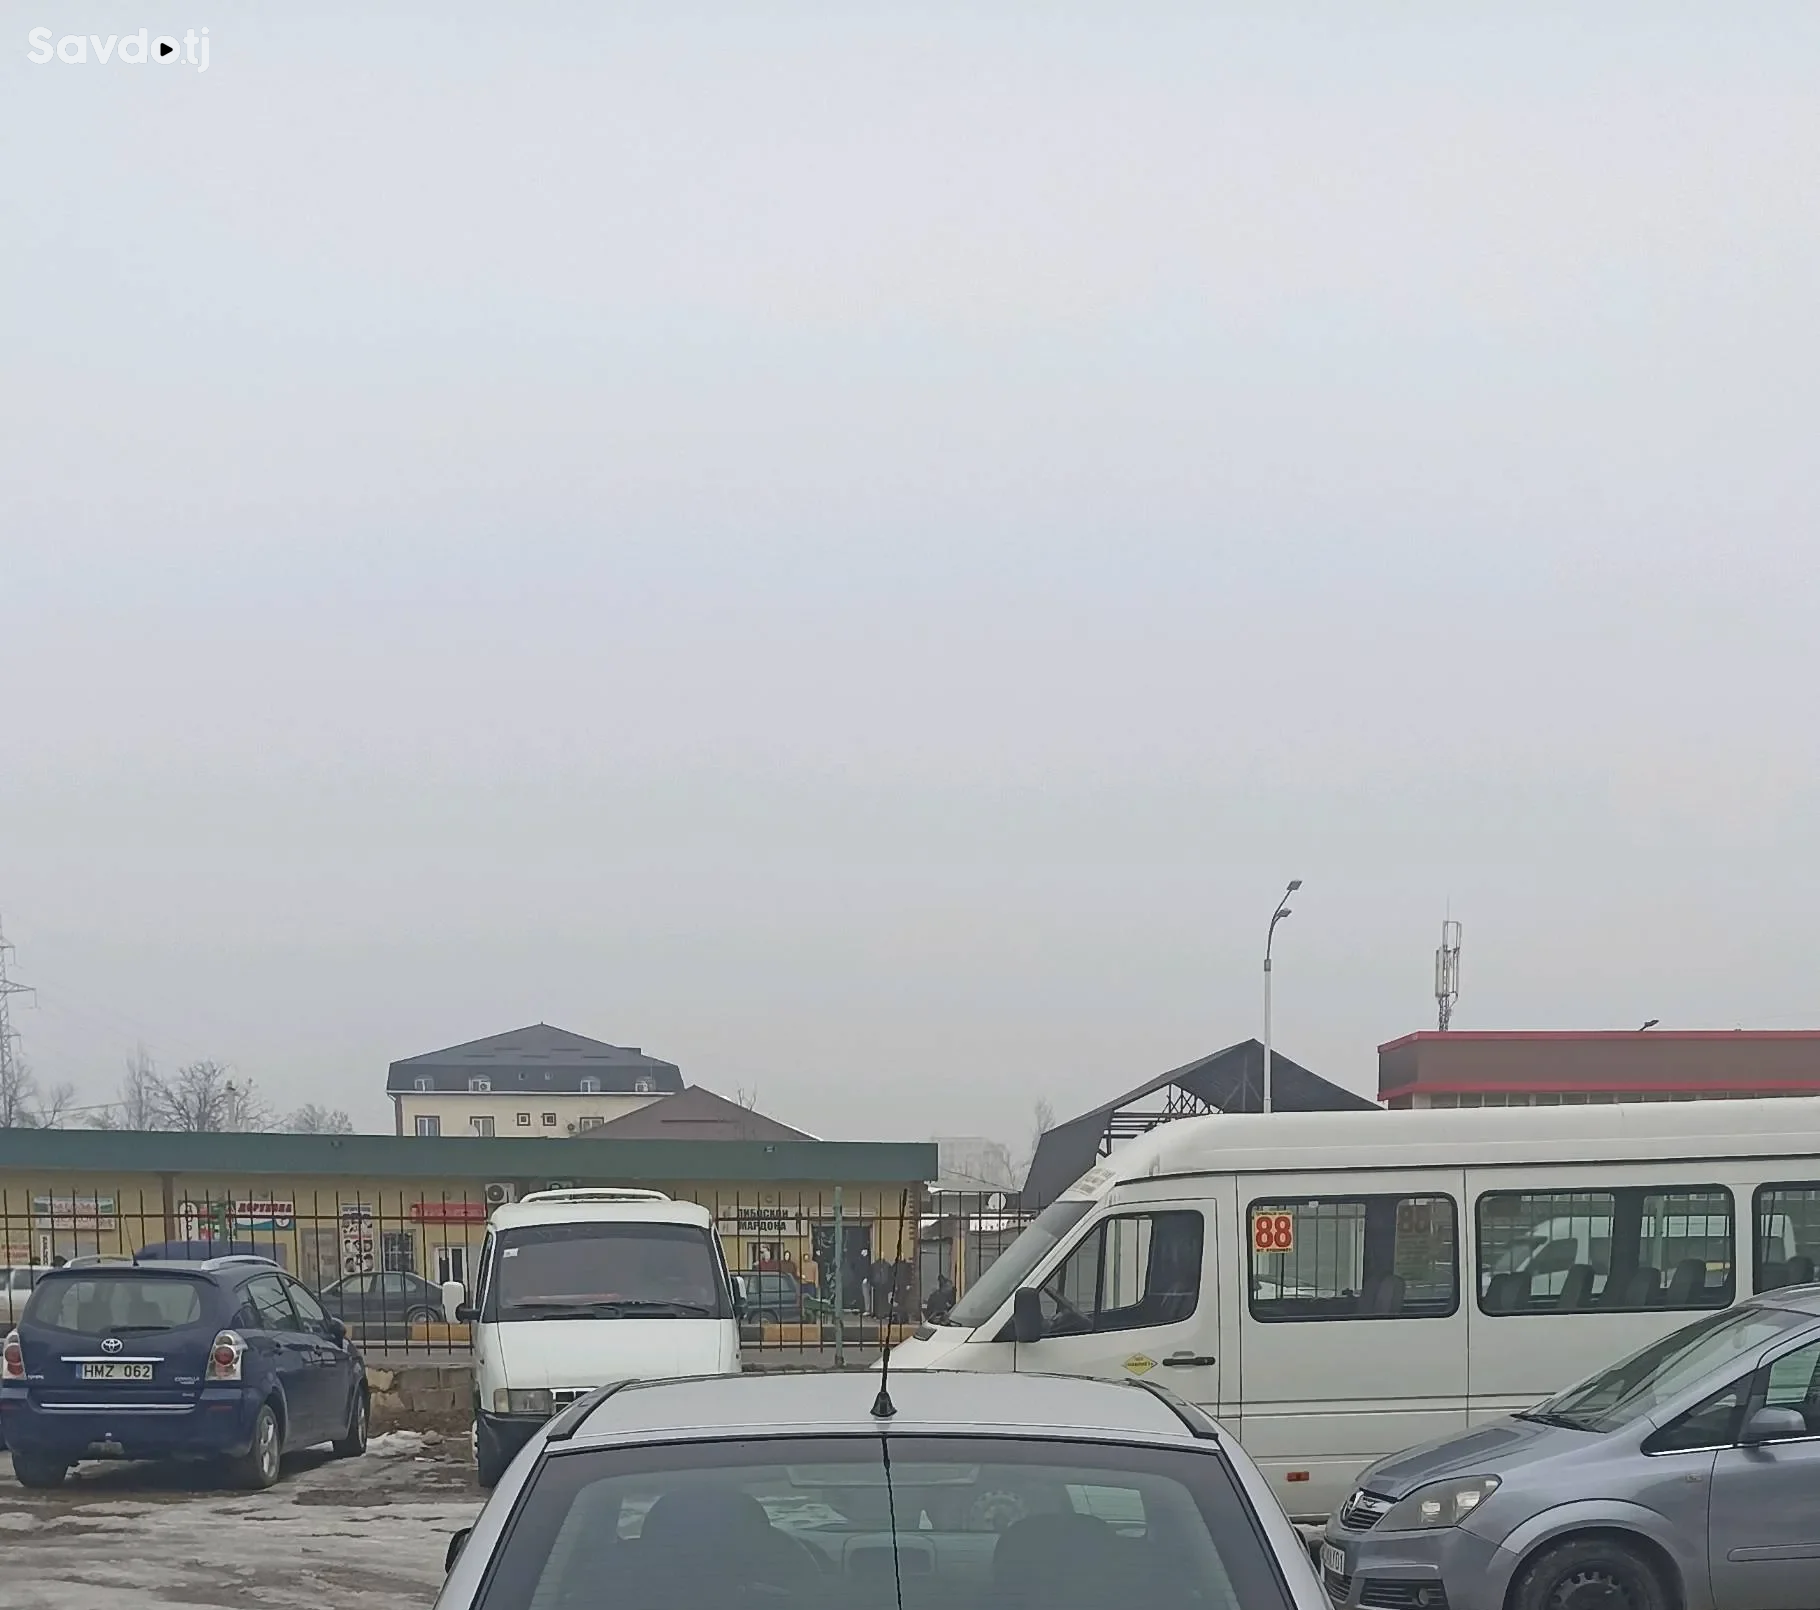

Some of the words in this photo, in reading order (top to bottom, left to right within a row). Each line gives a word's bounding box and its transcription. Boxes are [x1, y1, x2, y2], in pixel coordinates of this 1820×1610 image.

[1256, 1216, 1292, 1248] 88
[84, 1365, 114, 1378] HMZ
[124, 1365, 151, 1378] 062
